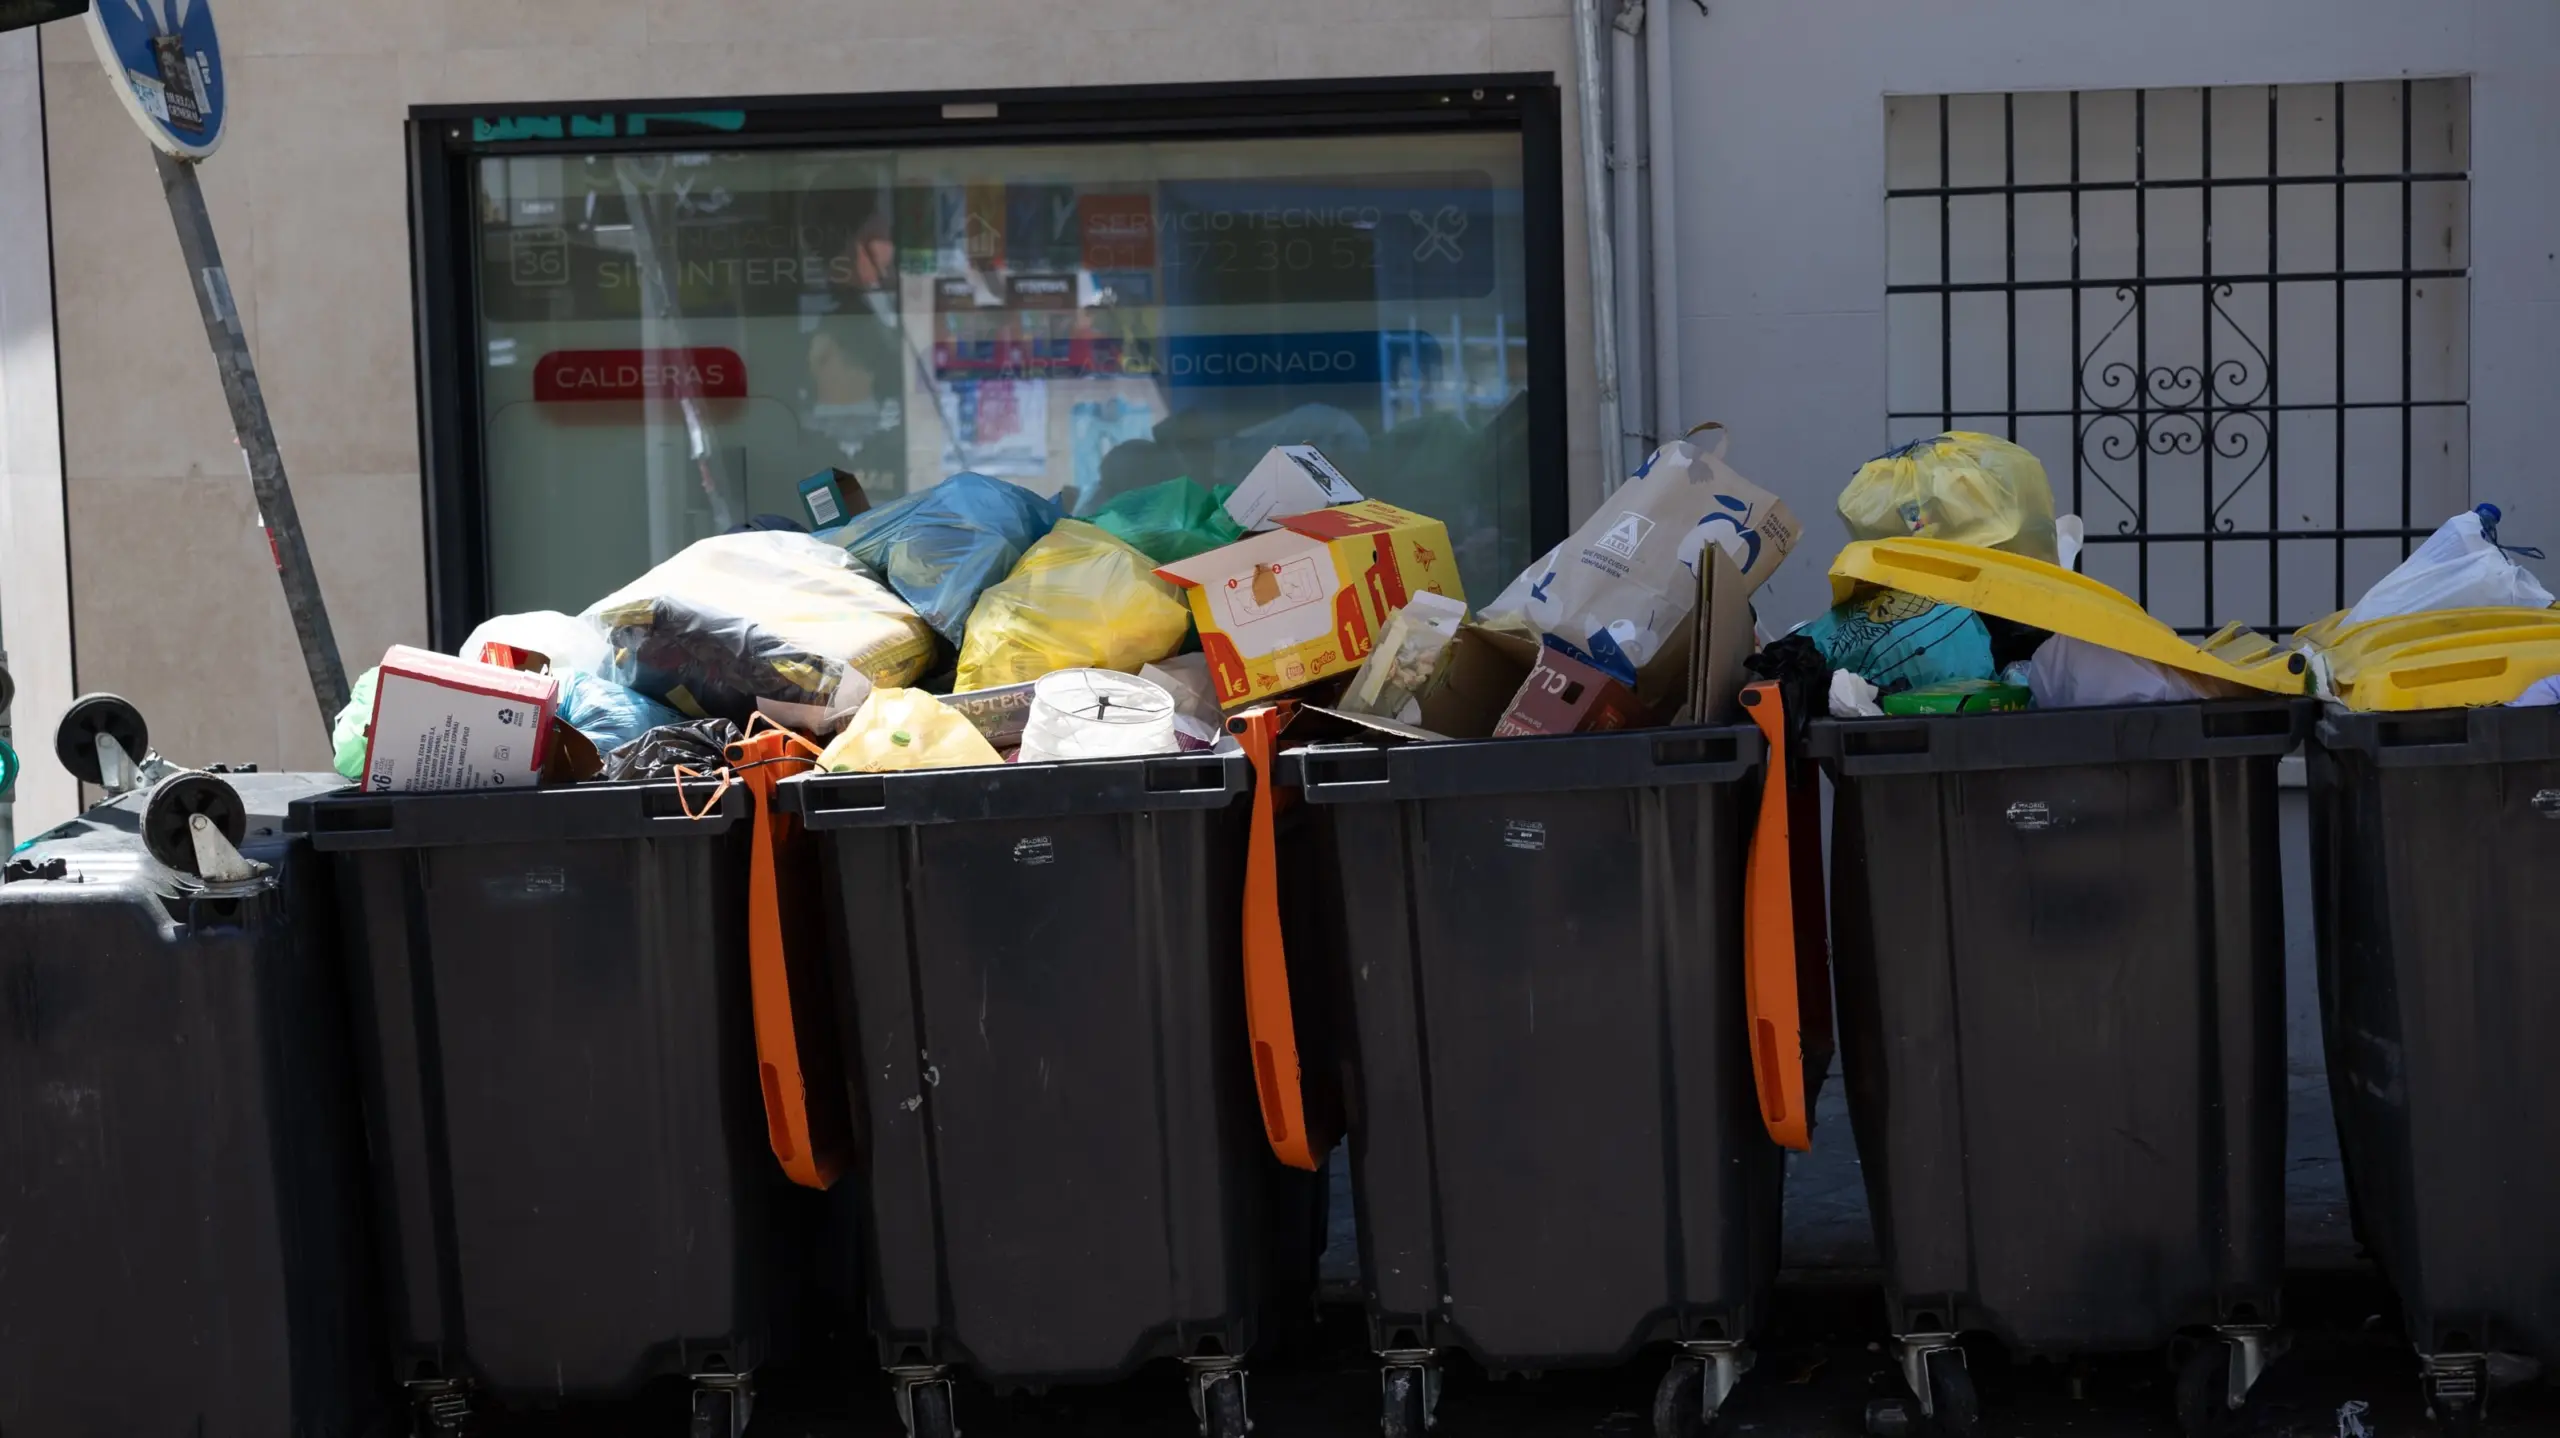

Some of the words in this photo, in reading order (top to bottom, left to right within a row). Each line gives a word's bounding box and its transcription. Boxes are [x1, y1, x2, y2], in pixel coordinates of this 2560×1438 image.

[1088, 210, 1233, 233] SERVICIO
[1242, 204, 1382, 230] TÉCNICO
[518, 249, 561, 276] 36
[597, 261, 665, 288] SIN
[675, 249, 852, 286] INTERÉS
[1255, 238, 1313, 271] 30
[556, 363, 725, 389] CALDERAS
[1000, 358, 1069, 379] AIRE
[1080, 350, 1356, 378] ACONDICIONADO
[1603, 538, 1631, 553] ALDI
[1344, 620, 1372, 657] 1€
[1218, 663, 1247, 696] 1€
